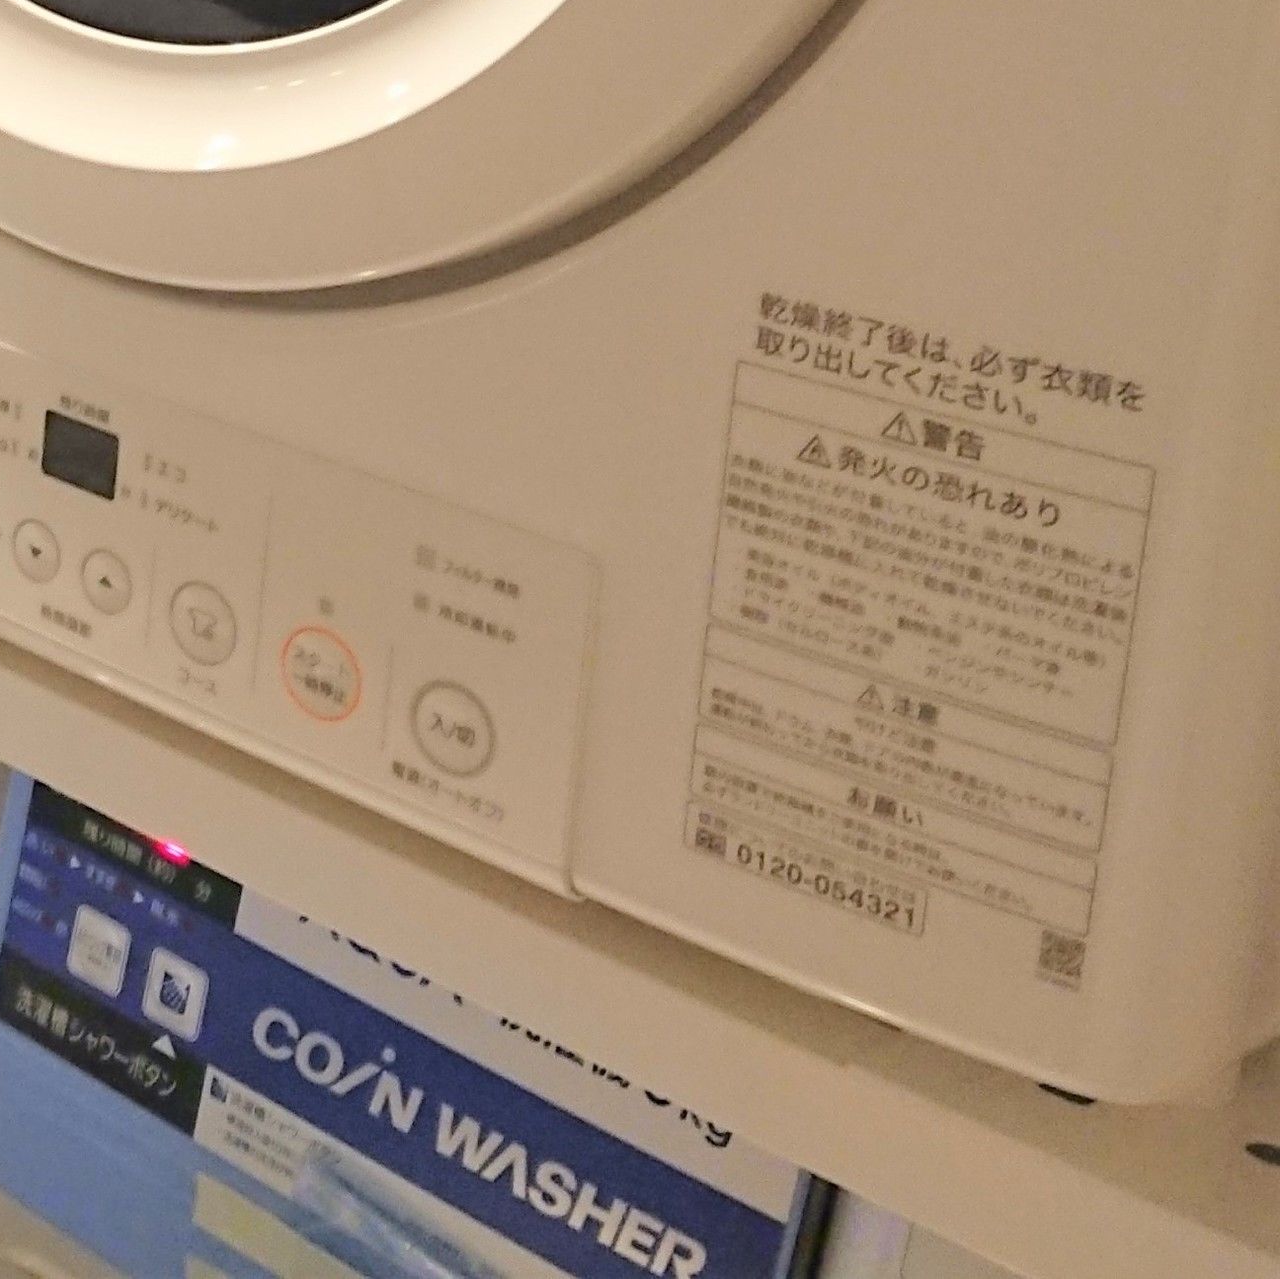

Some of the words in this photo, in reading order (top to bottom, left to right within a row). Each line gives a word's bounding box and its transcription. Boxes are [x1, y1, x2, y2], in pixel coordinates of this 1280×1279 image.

[756, 325, 1038, 425] 取り出してください。
[760, 291, 1146, 413] 乾燥終了後は、必ず衣類を
[924, 418, 986, 462] 警告
[840, 444, 1061, 529] 発火の恐れあり
[737, 843, 915, 928] 0120-054321
[435, 1103, 708, 1279] WASHER
